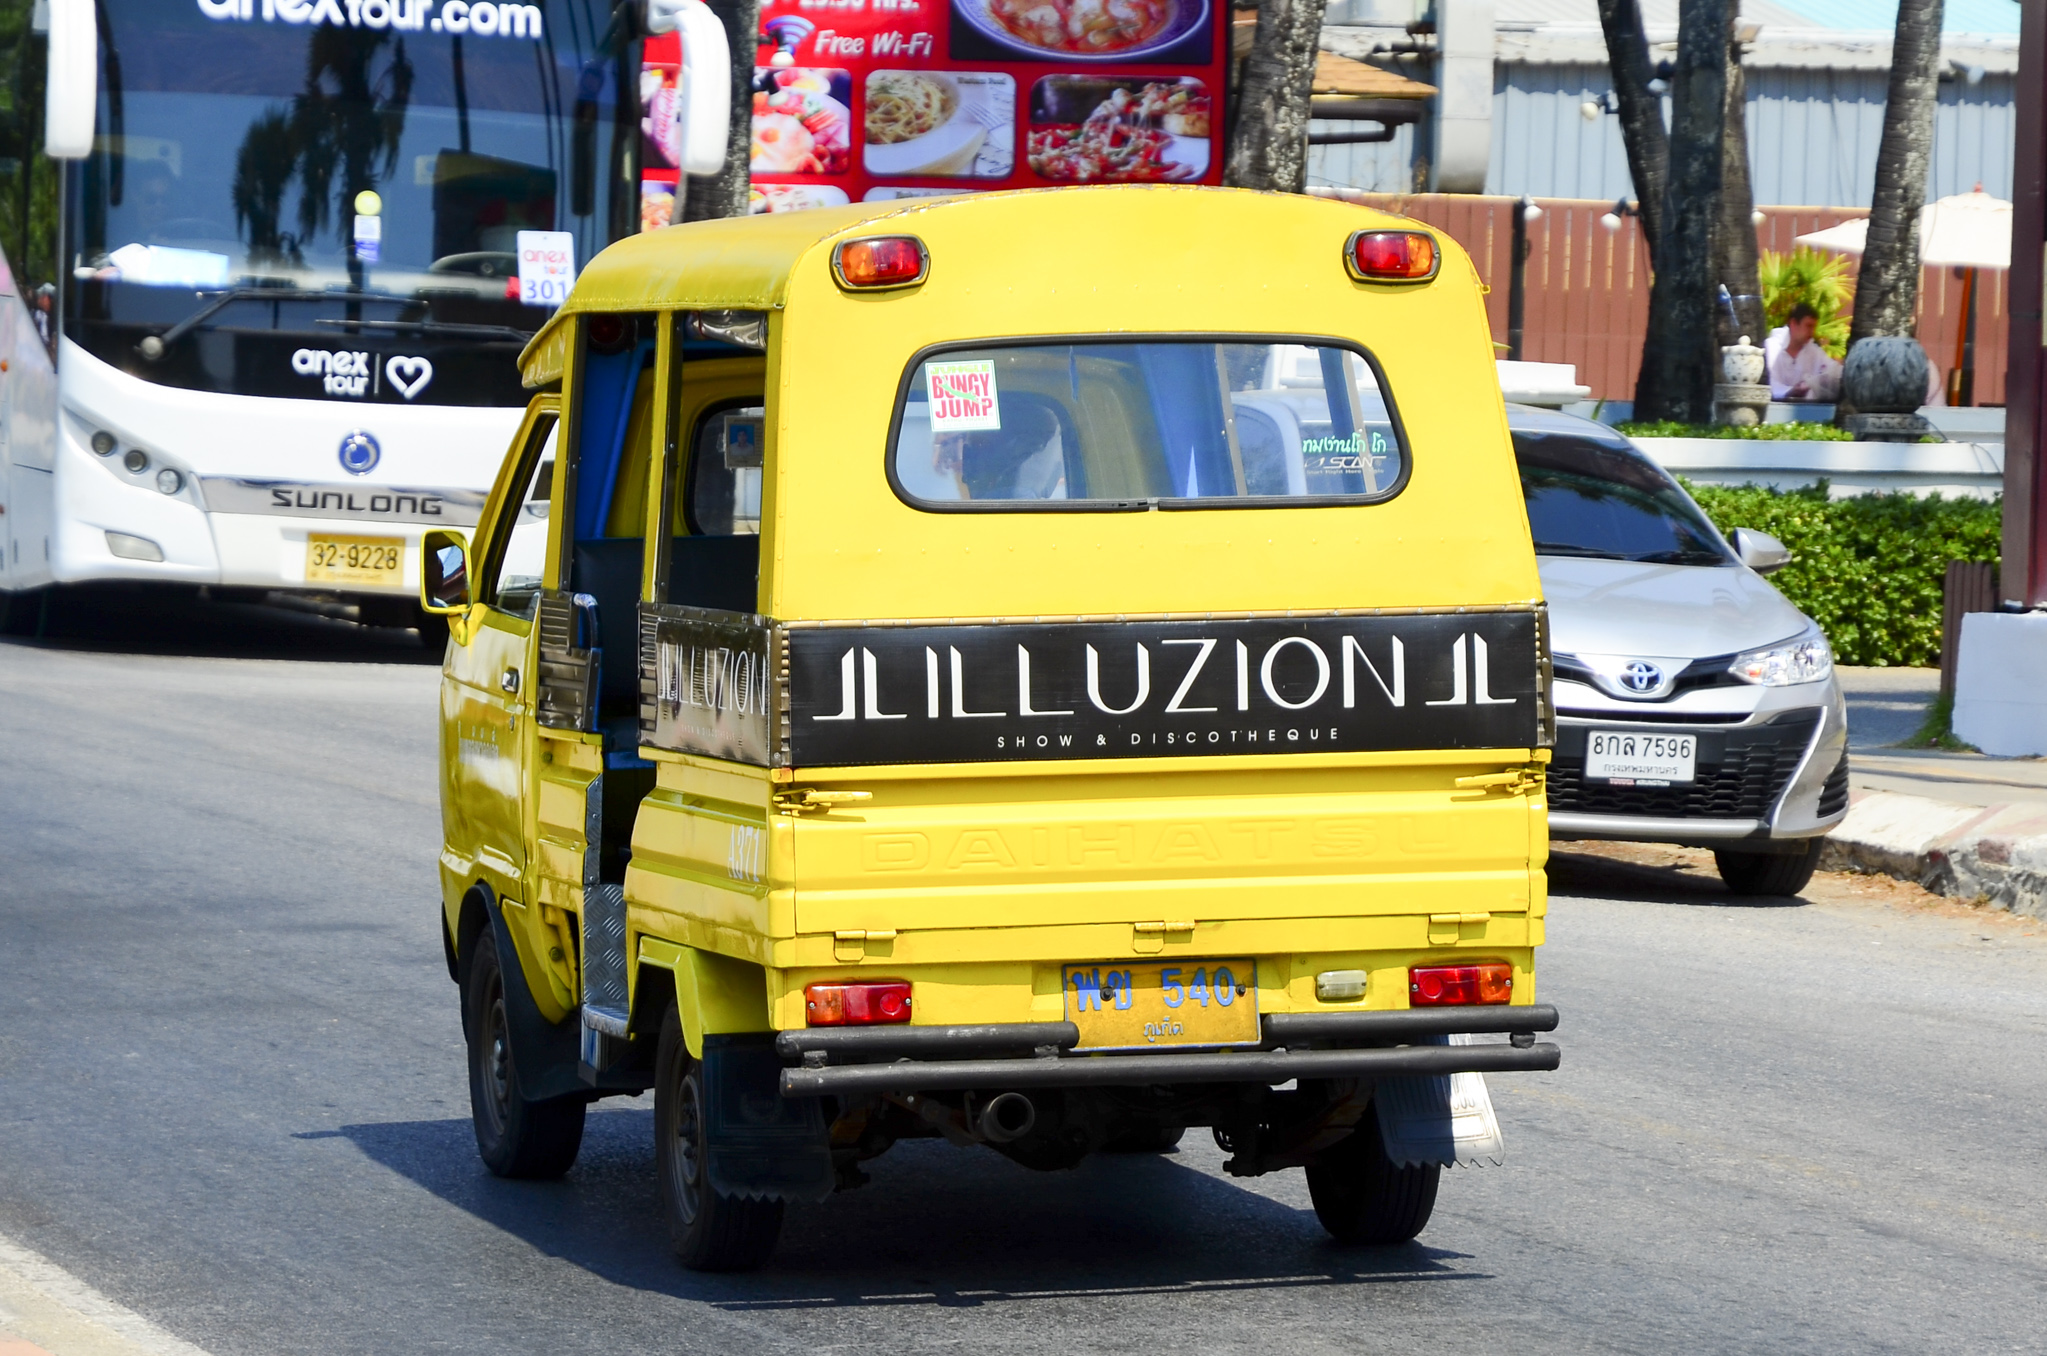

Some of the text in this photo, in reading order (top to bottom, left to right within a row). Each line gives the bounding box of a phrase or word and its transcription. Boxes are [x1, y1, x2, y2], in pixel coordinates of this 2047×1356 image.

[813, 29, 934, 57] Free Wi-Fi
[523, 249, 568, 263] anex
[525, 279, 567, 300] 301
[292, 348, 369, 377] anex
[323, 374, 369, 395] tour
[932, 373, 989, 399] BUNGY
[935, 398, 993, 418] JUMP
[271, 488, 443, 515] SUNLONG
[313, 544, 398, 570] 32-9228
[926, 634, 1406, 719] ILLUZION
[997, 727, 1338, 748] SHOW & DISCOTHEQUE
[1593, 735, 1691, 758] 8กล 7596
[861, 815, 1459, 873] DAIHATSU
[1160, 966, 1237, 1008] 540
